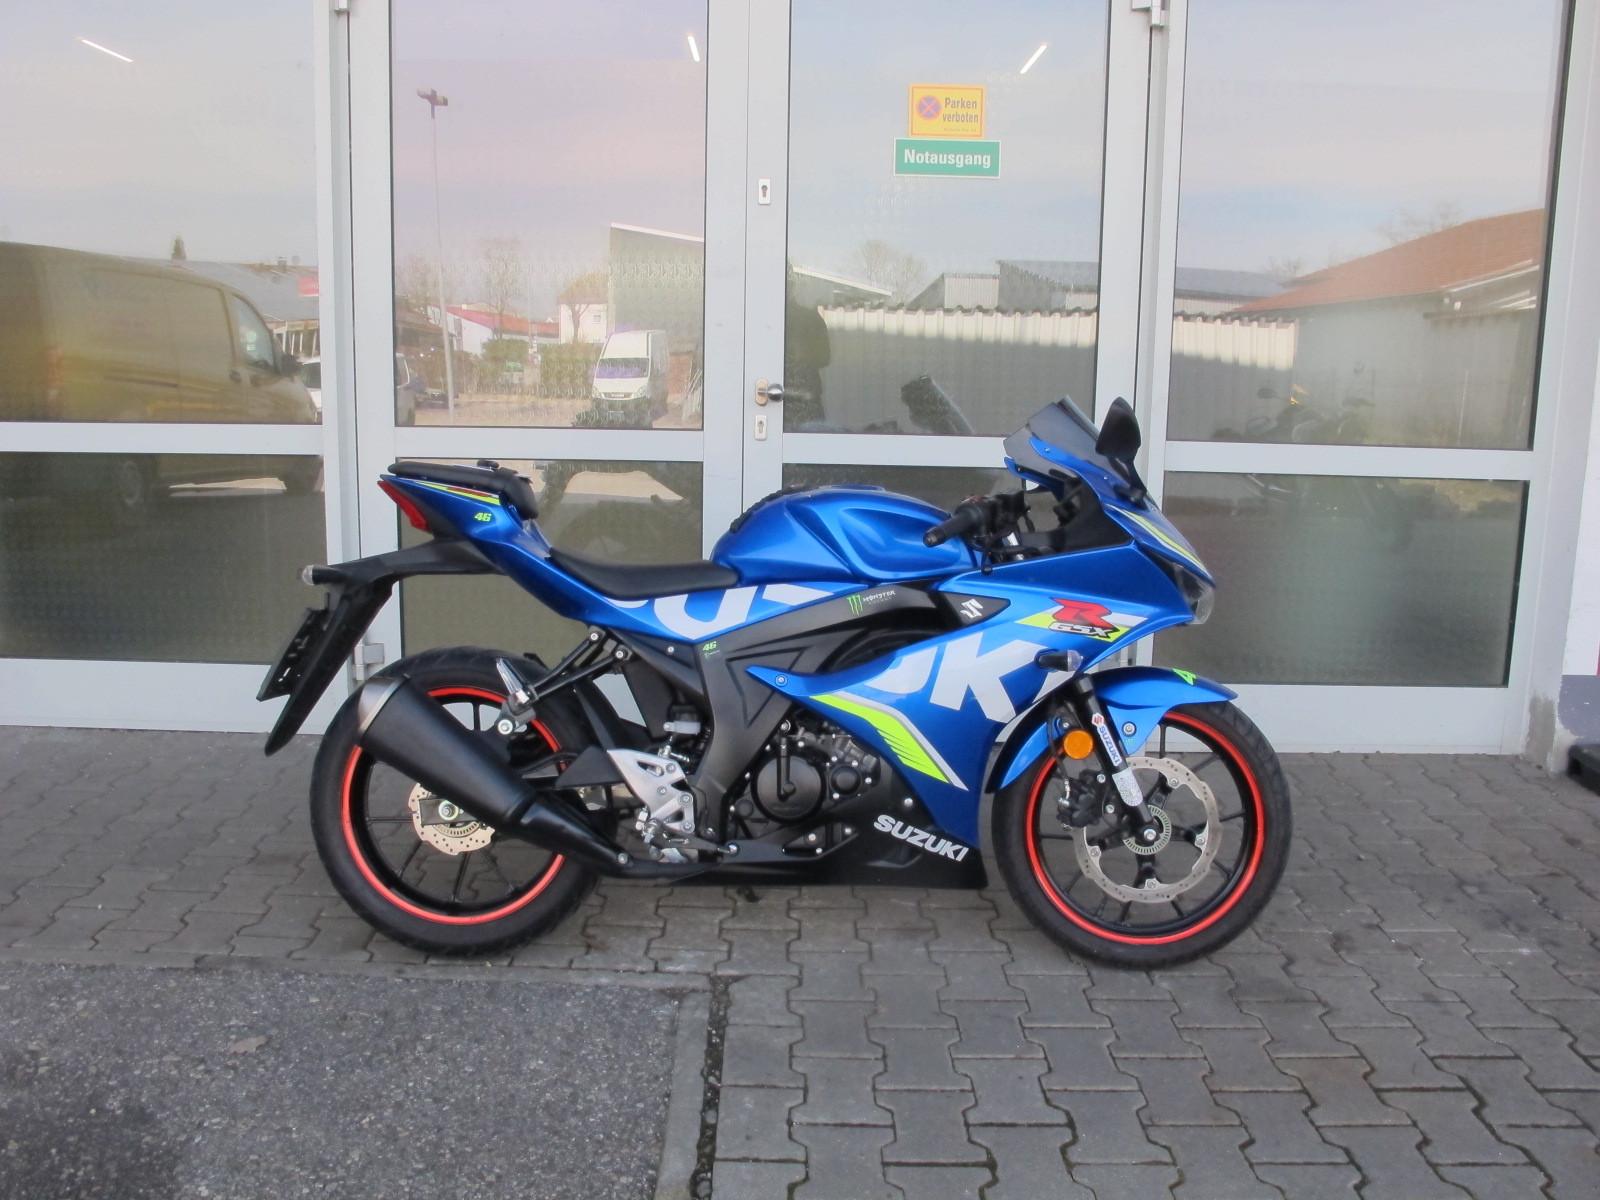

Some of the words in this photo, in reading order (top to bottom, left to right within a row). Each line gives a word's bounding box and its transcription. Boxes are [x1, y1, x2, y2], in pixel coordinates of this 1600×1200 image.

[944, 97, 978, 109] Parken
[943, 112, 979, 123] verboten
[904, 149, 991, 168] Notausgang
[474, 512, 492, 522] 46
[1048, 621, 1112, 639] GSX
[702, 640, 717, 651] 46
[1099, 725, 1121, 765] SUZUKI
[873, 814, 969, 862] SUZUKI
